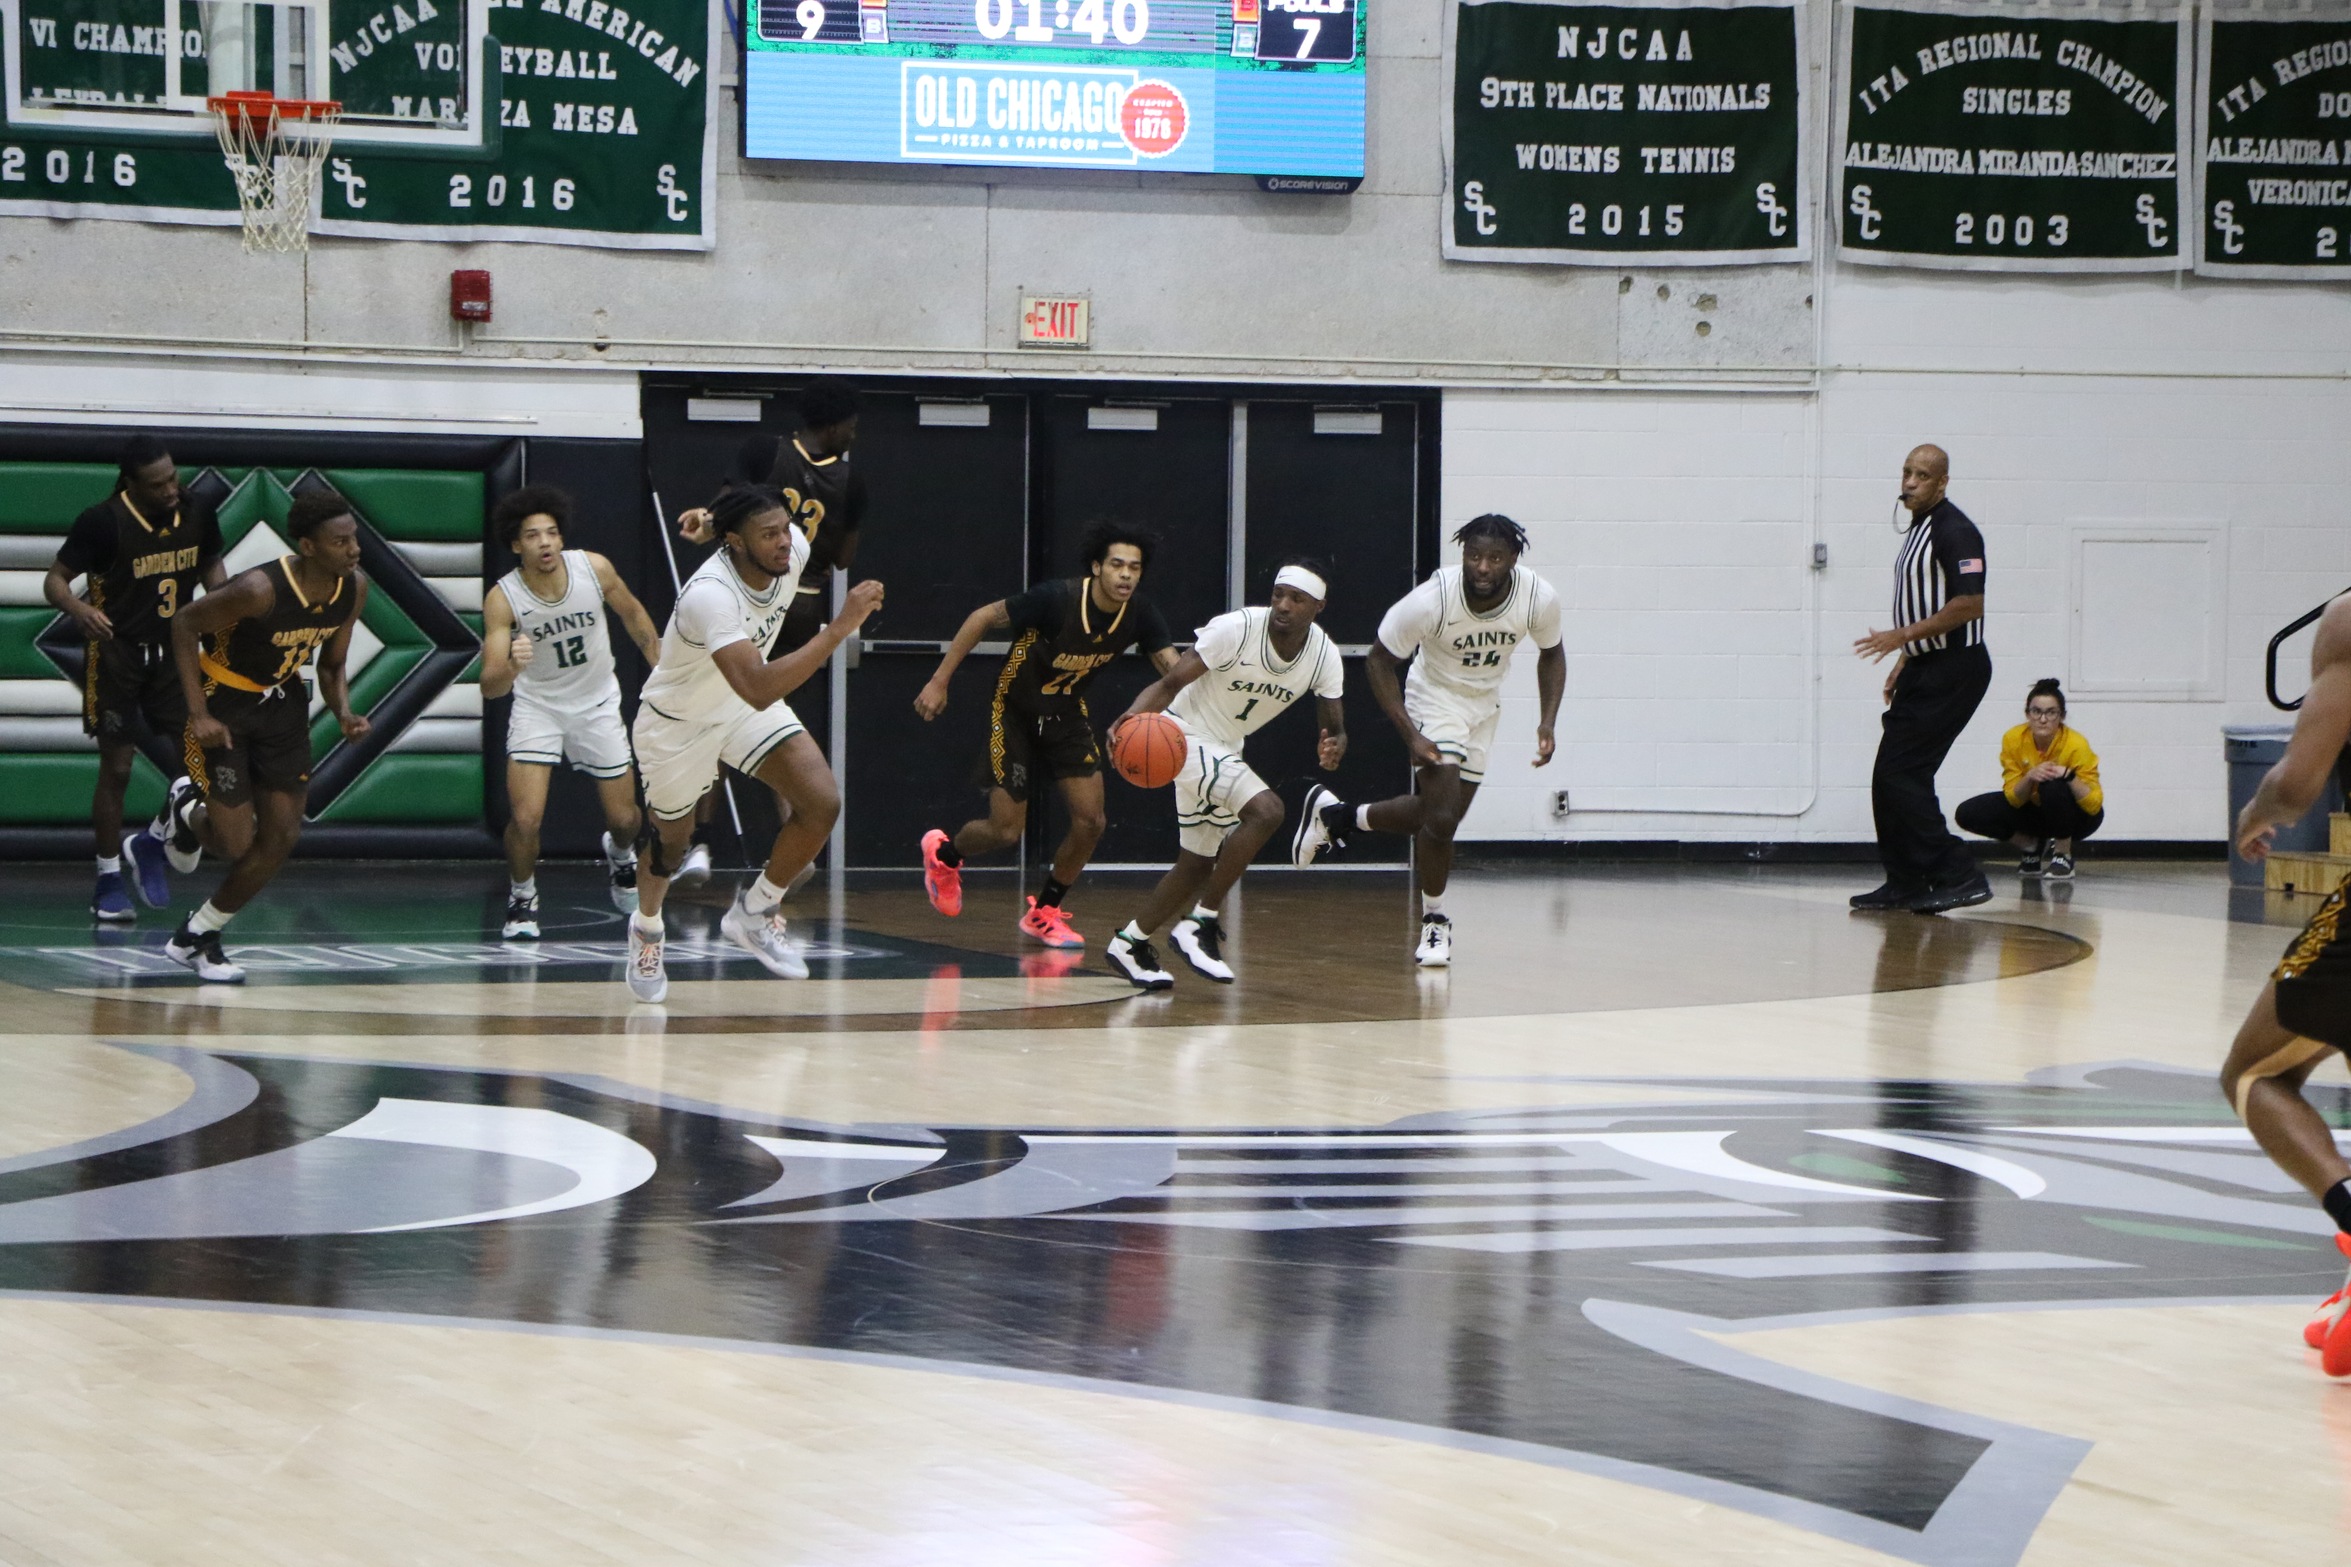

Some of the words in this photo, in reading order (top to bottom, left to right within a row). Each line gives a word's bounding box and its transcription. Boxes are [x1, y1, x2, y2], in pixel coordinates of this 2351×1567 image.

[29, 18, 57, 48] VI
[330, 0, 438, 73] NJCAA
[796, 0, 825, 40] 9
[975, 0, 1149, 45] 01:40
[1293, 18, 1321, 59] 7
[1557, 26, 1693, 61] NJCAA
[415, 42, 617, 80] VOEYBALL
[1859, 65, 1909, 115] ITA
[1917, 31, 2042, 75] REGIONAL
[2056, 39, 2170, 125] CHAMPION
[1481, 77, 1535, 108] 9TH
[1545, 82, 1624, 111] PLACE
[1638, 83, 1771, 112] NATIONALS
[2217, 76, 2268, 122] ITA
[2272, 40, 2351, 86] REGIO
[392, 96, 531, 128] MARZA
[553, 103, 638, 135] MESA
[915, 75, 976, 129] OLD
[987, 77, 1125, 133] CHICAGO
[1962, 86, 2072, 116] SINGLES
[941, 134, 992, 148] PIZZA
[998, 135, 1009, 149] &
[1016, 137, 1099, 151] TAPROOM
[1516, 143, 1620, 173] WOMENS
[1641, 146, 1736, 174] TENNIS
[1845, 142, 1974, 175] ALEJANDRA
[2207, 137, 2340, 165] ALEJANDRA
[2, 147, 137, 187] 2016
[450, 175, 575, 211] 2016
[657, 164, 688, 221] SC
[2248, 179, 2351, 206] VERONIC
[1568, 203, 1684, 236] 2015
[1956, 212, 2069, 246] 2003
[1033, 301, 1079, 338] EXIT
[158, 578, 178, 618] 3
[532, 611, 596, 643] SAINTS
[1452, 631, 1517, 651] SAINTS
[552, 634, 588, 669] 12
[1227, 680, 1294, 703] SAINTS
[1235, 698, 1259, 722] 1
